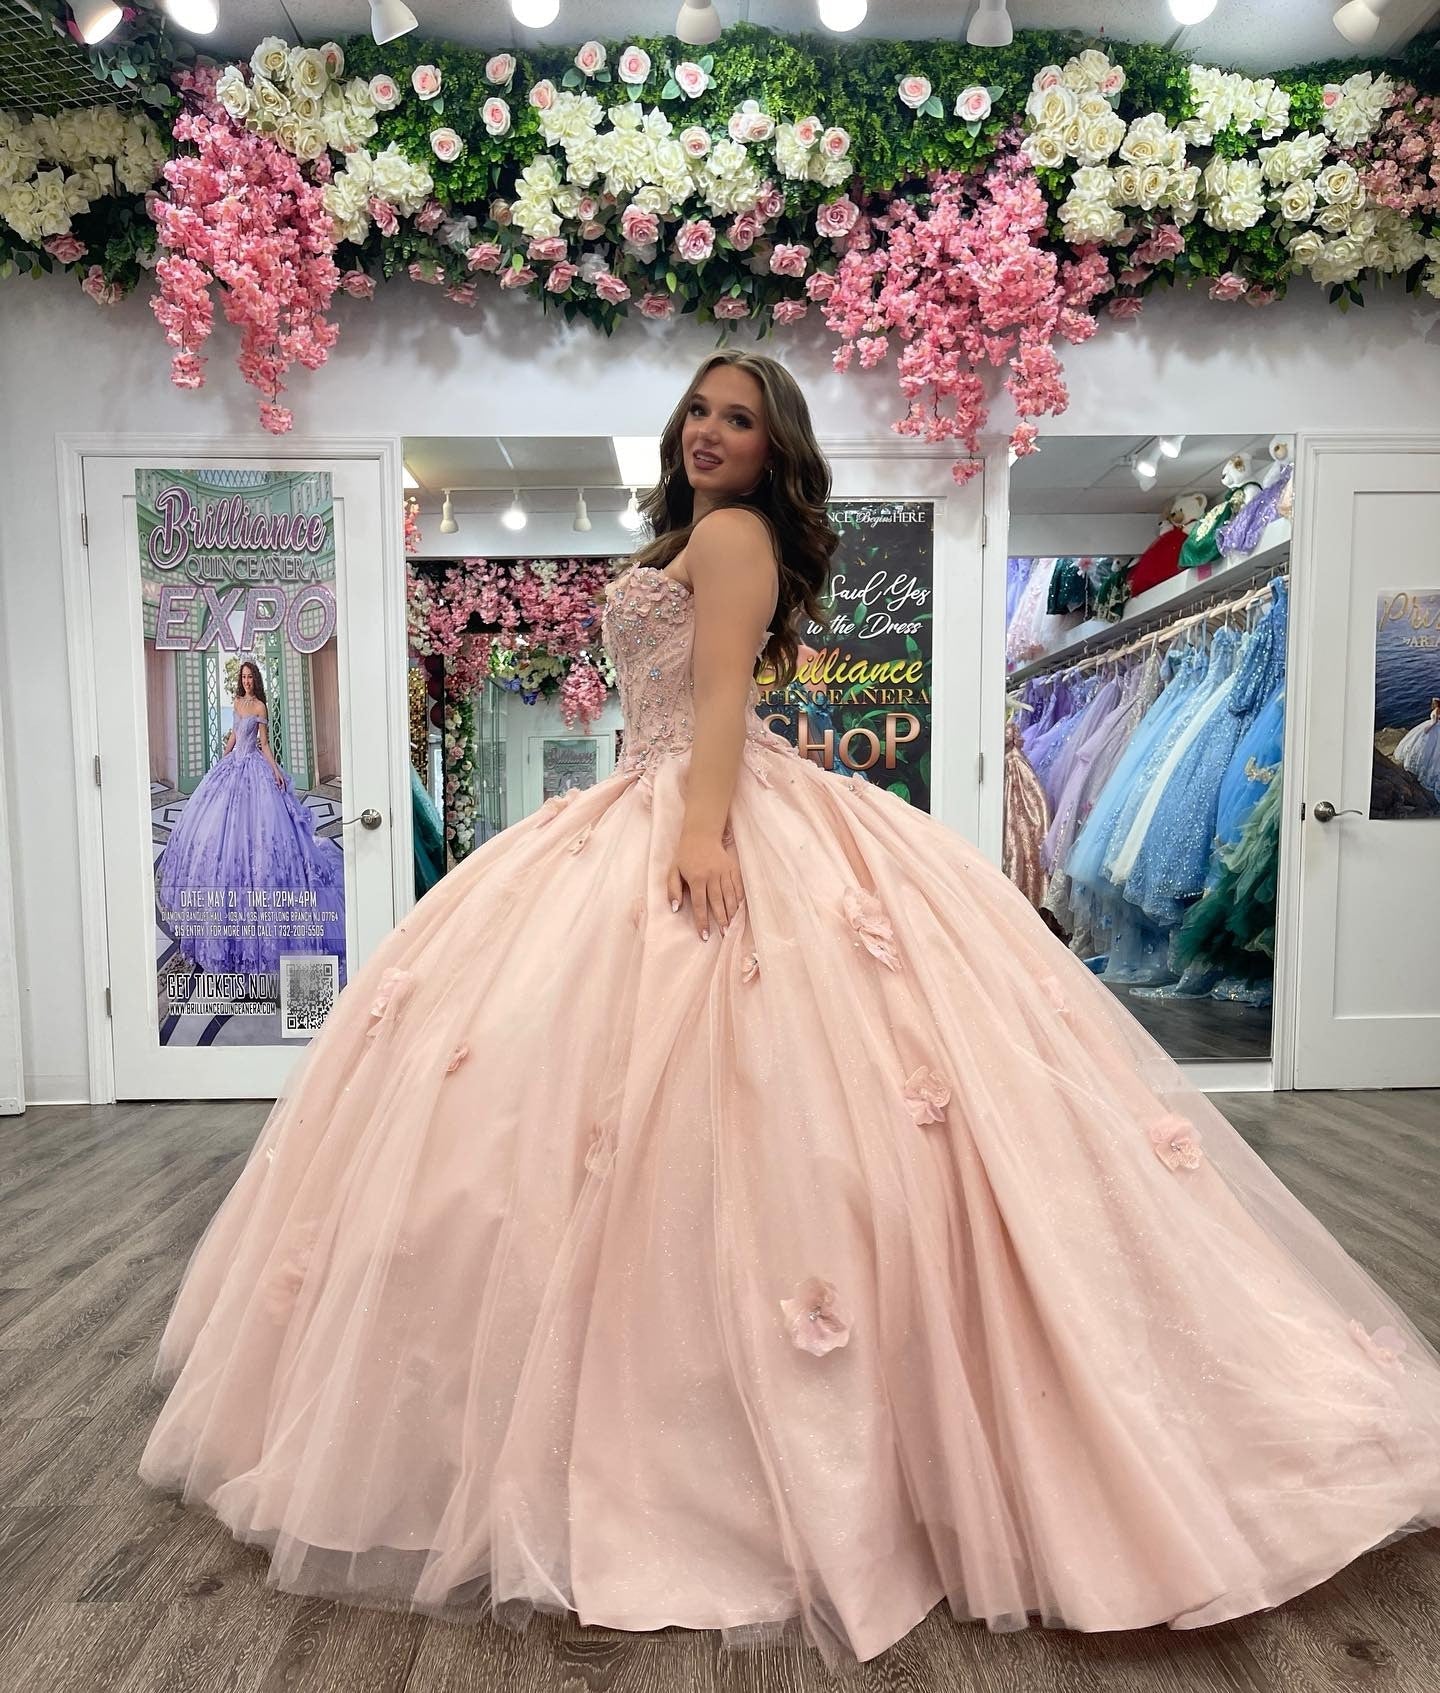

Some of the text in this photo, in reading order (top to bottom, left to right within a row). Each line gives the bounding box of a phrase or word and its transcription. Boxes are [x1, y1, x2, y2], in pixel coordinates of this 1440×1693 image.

[149, 486, 325, 569] Brilliance
[856, 512, 892, 528] Begins
[893, 512, 926, 522] HERE
[884, 574, 932, 612] Yes
[155, 584, 336, 654] EXPO
[830, 614, 856, 634] the
[858, 612, 924, 639] Dress
[756, 648, 923, 685] illiance
[757, 686, 930, 705] UINCEAÑERA
[181, 890, 237, 908] DATE: MAY 21
[247, 890, 317, 908] TIME: 12PM-4PM
[260, 912, 274, 922] WEST
[275, 912, 289, 922] LONG
[186, 925, 204, 937] ENTRY
[210, 925, 222, 937] FOR
[224, 925, 240, 937] MORE
[242, 925, 255, 937] INFO
[258, 925, 272, 937] CALL
[167, 974, 278, 999] GET TICKETS NOW
